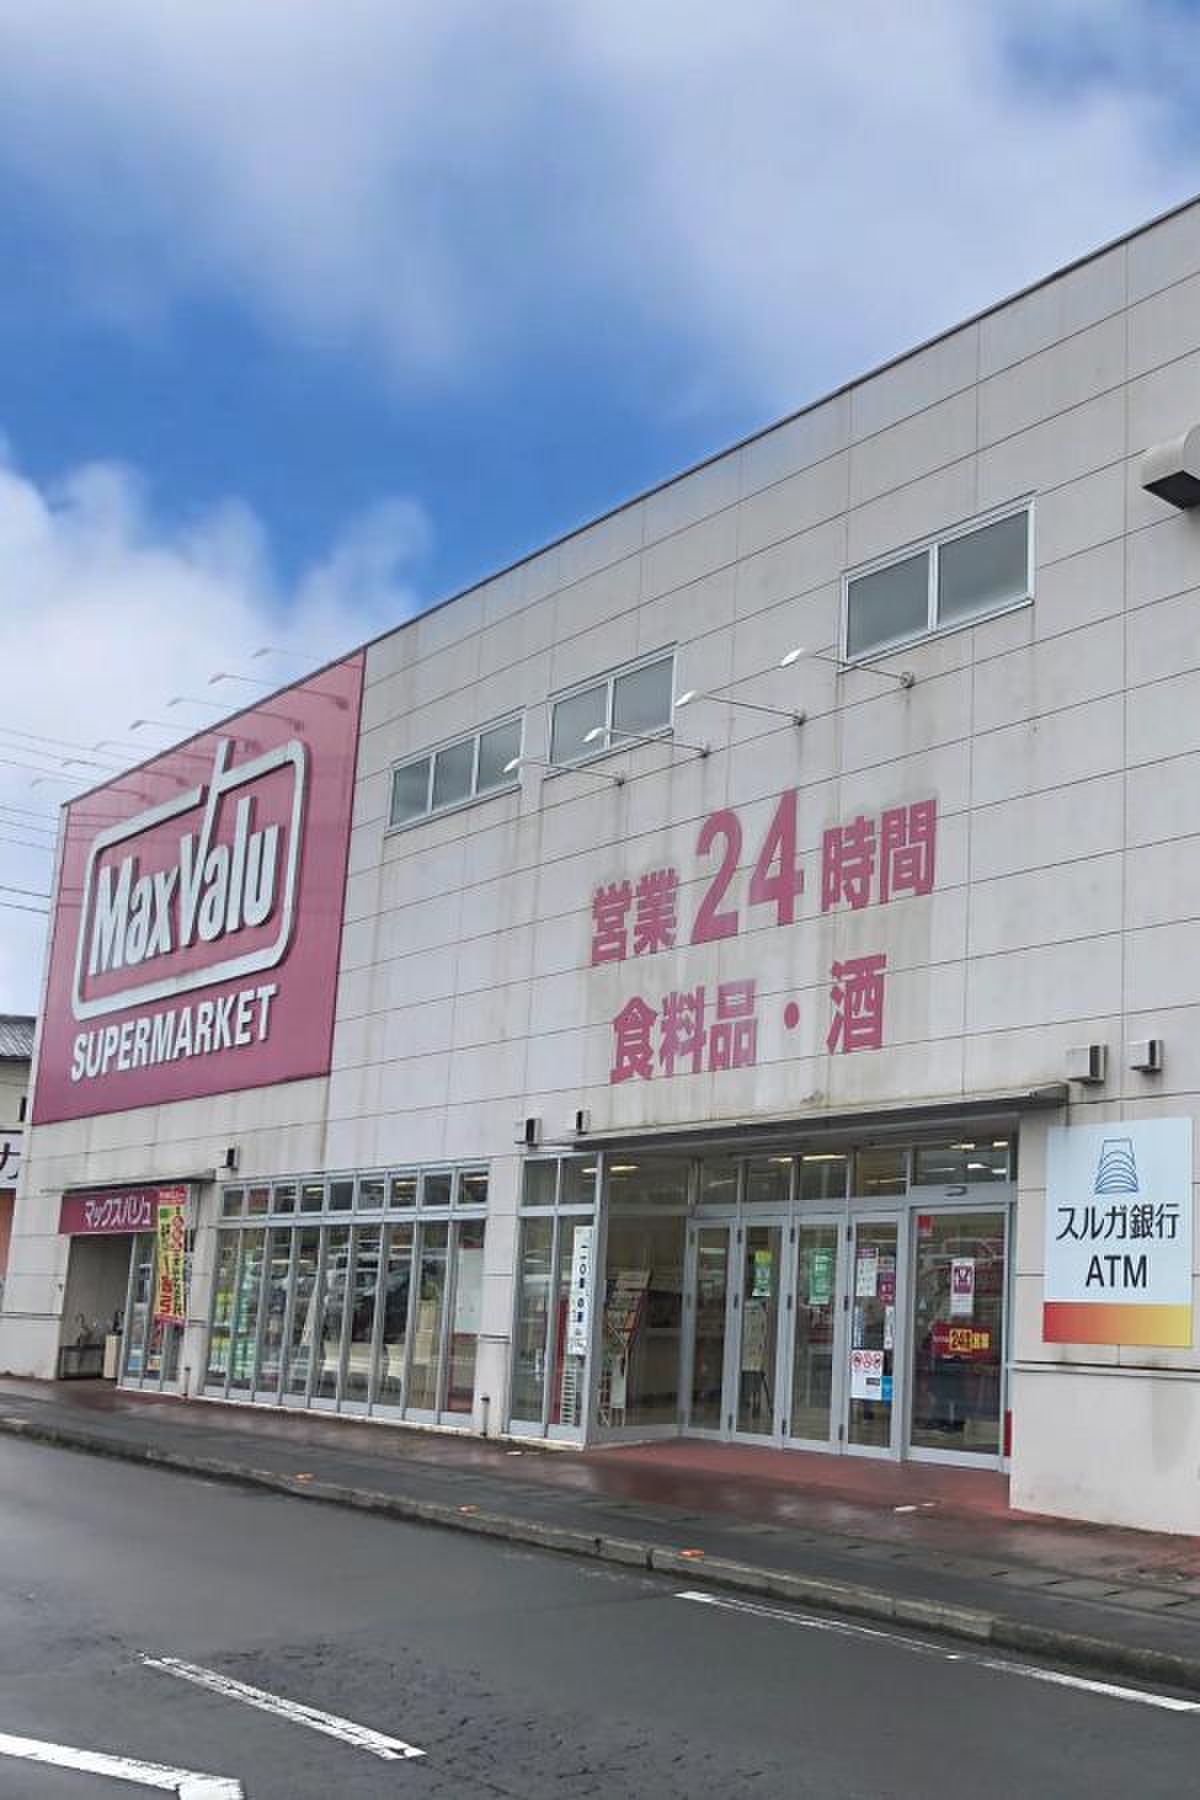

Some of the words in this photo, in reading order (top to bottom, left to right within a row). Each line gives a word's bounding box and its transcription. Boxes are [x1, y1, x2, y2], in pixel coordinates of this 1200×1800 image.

[89, 740, 281, 978] MaxValu
[71, 984, 278, 1082] SUPERMARKET
[609, 953, 887, 1084] 食料品・酒
[1056, 1203, 1180, 1241] スルガ銀行
[1085, 1254, 1149, 1289] ATM
